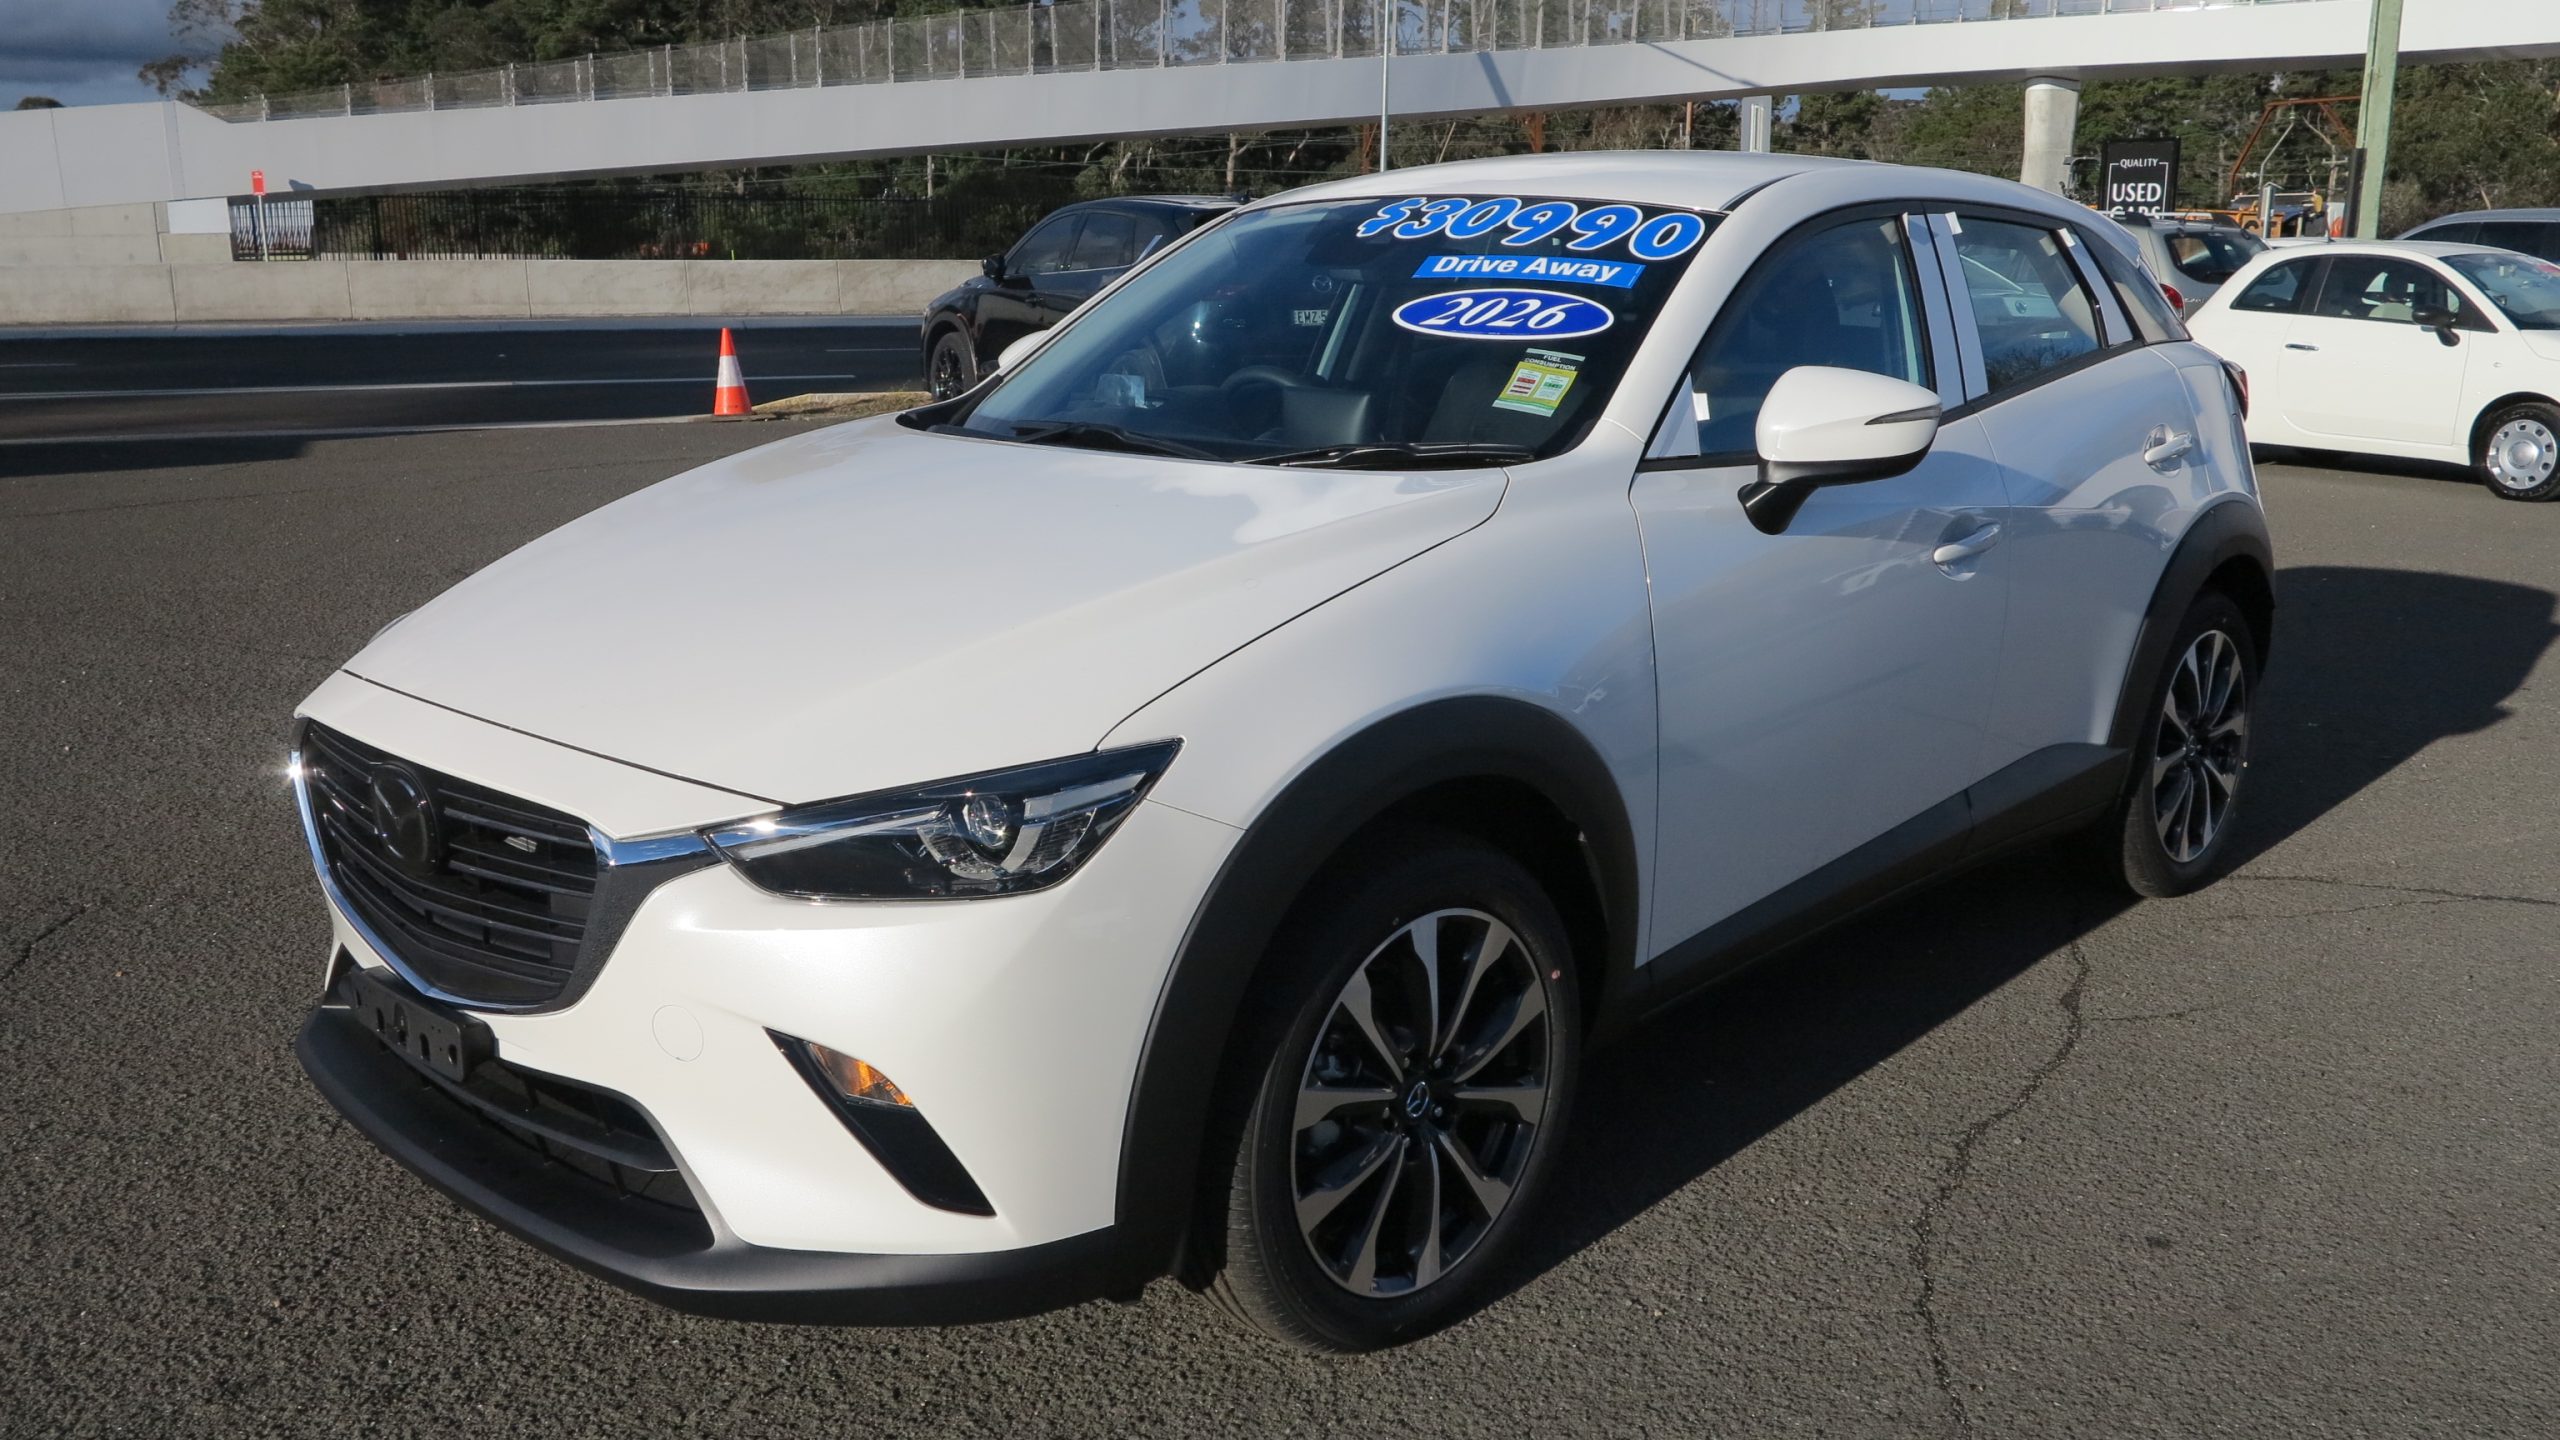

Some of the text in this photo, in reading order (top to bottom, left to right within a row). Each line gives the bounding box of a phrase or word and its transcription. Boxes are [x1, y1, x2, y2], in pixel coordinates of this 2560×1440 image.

[2120, 158, 2159, 169] QUALITY
[2112, 182, 2161, 202] USED
[1355, 197, 1706, 261] $30990
[1432, 255, 1622, 282] Drive Away
[1419, 296, 1586, 329] 2026
[1524, 357, 1577, 371] CONSUMPTION
[1543, 354, 1562, 363] FUEL
